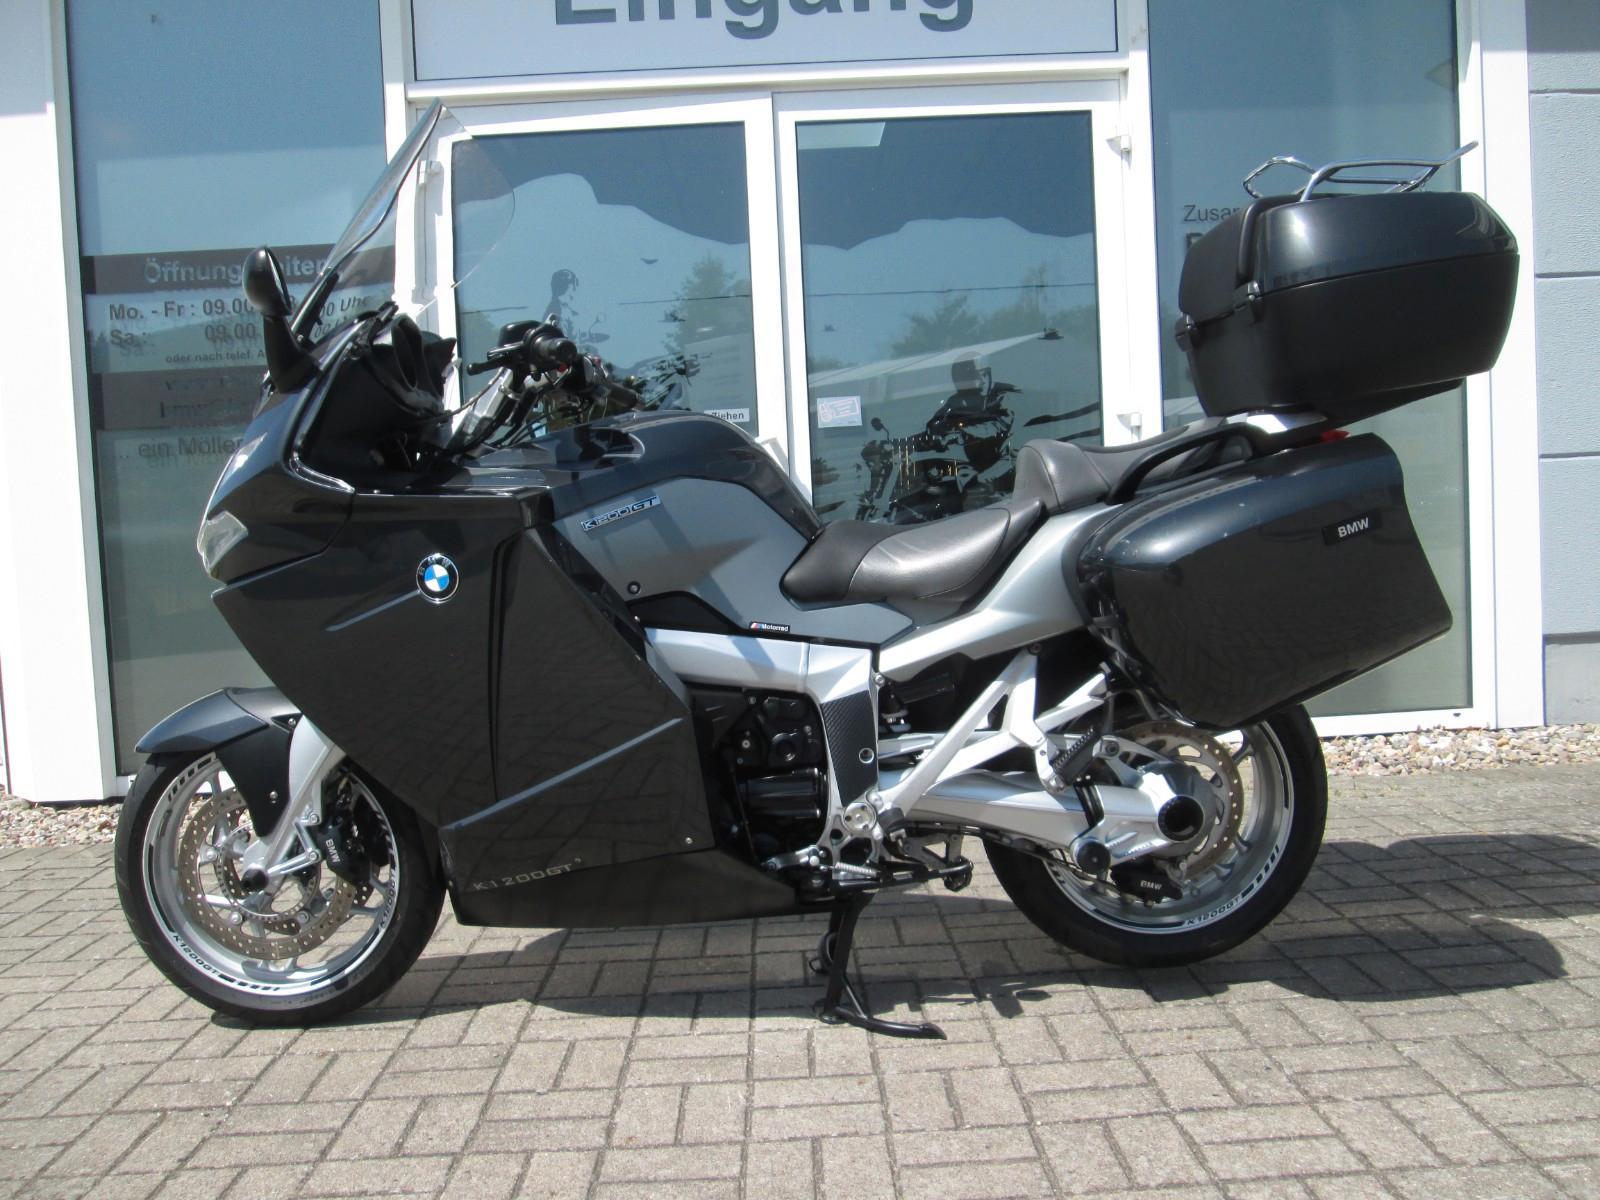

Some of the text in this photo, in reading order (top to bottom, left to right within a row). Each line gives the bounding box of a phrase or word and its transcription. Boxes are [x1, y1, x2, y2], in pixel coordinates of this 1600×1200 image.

[109, 303, 144, 320] Mo.
[1338, 517, 1369, 538] BMW
[325, 838, 340, 862] BMW
[1140, 880, 1162, 890] BMW
